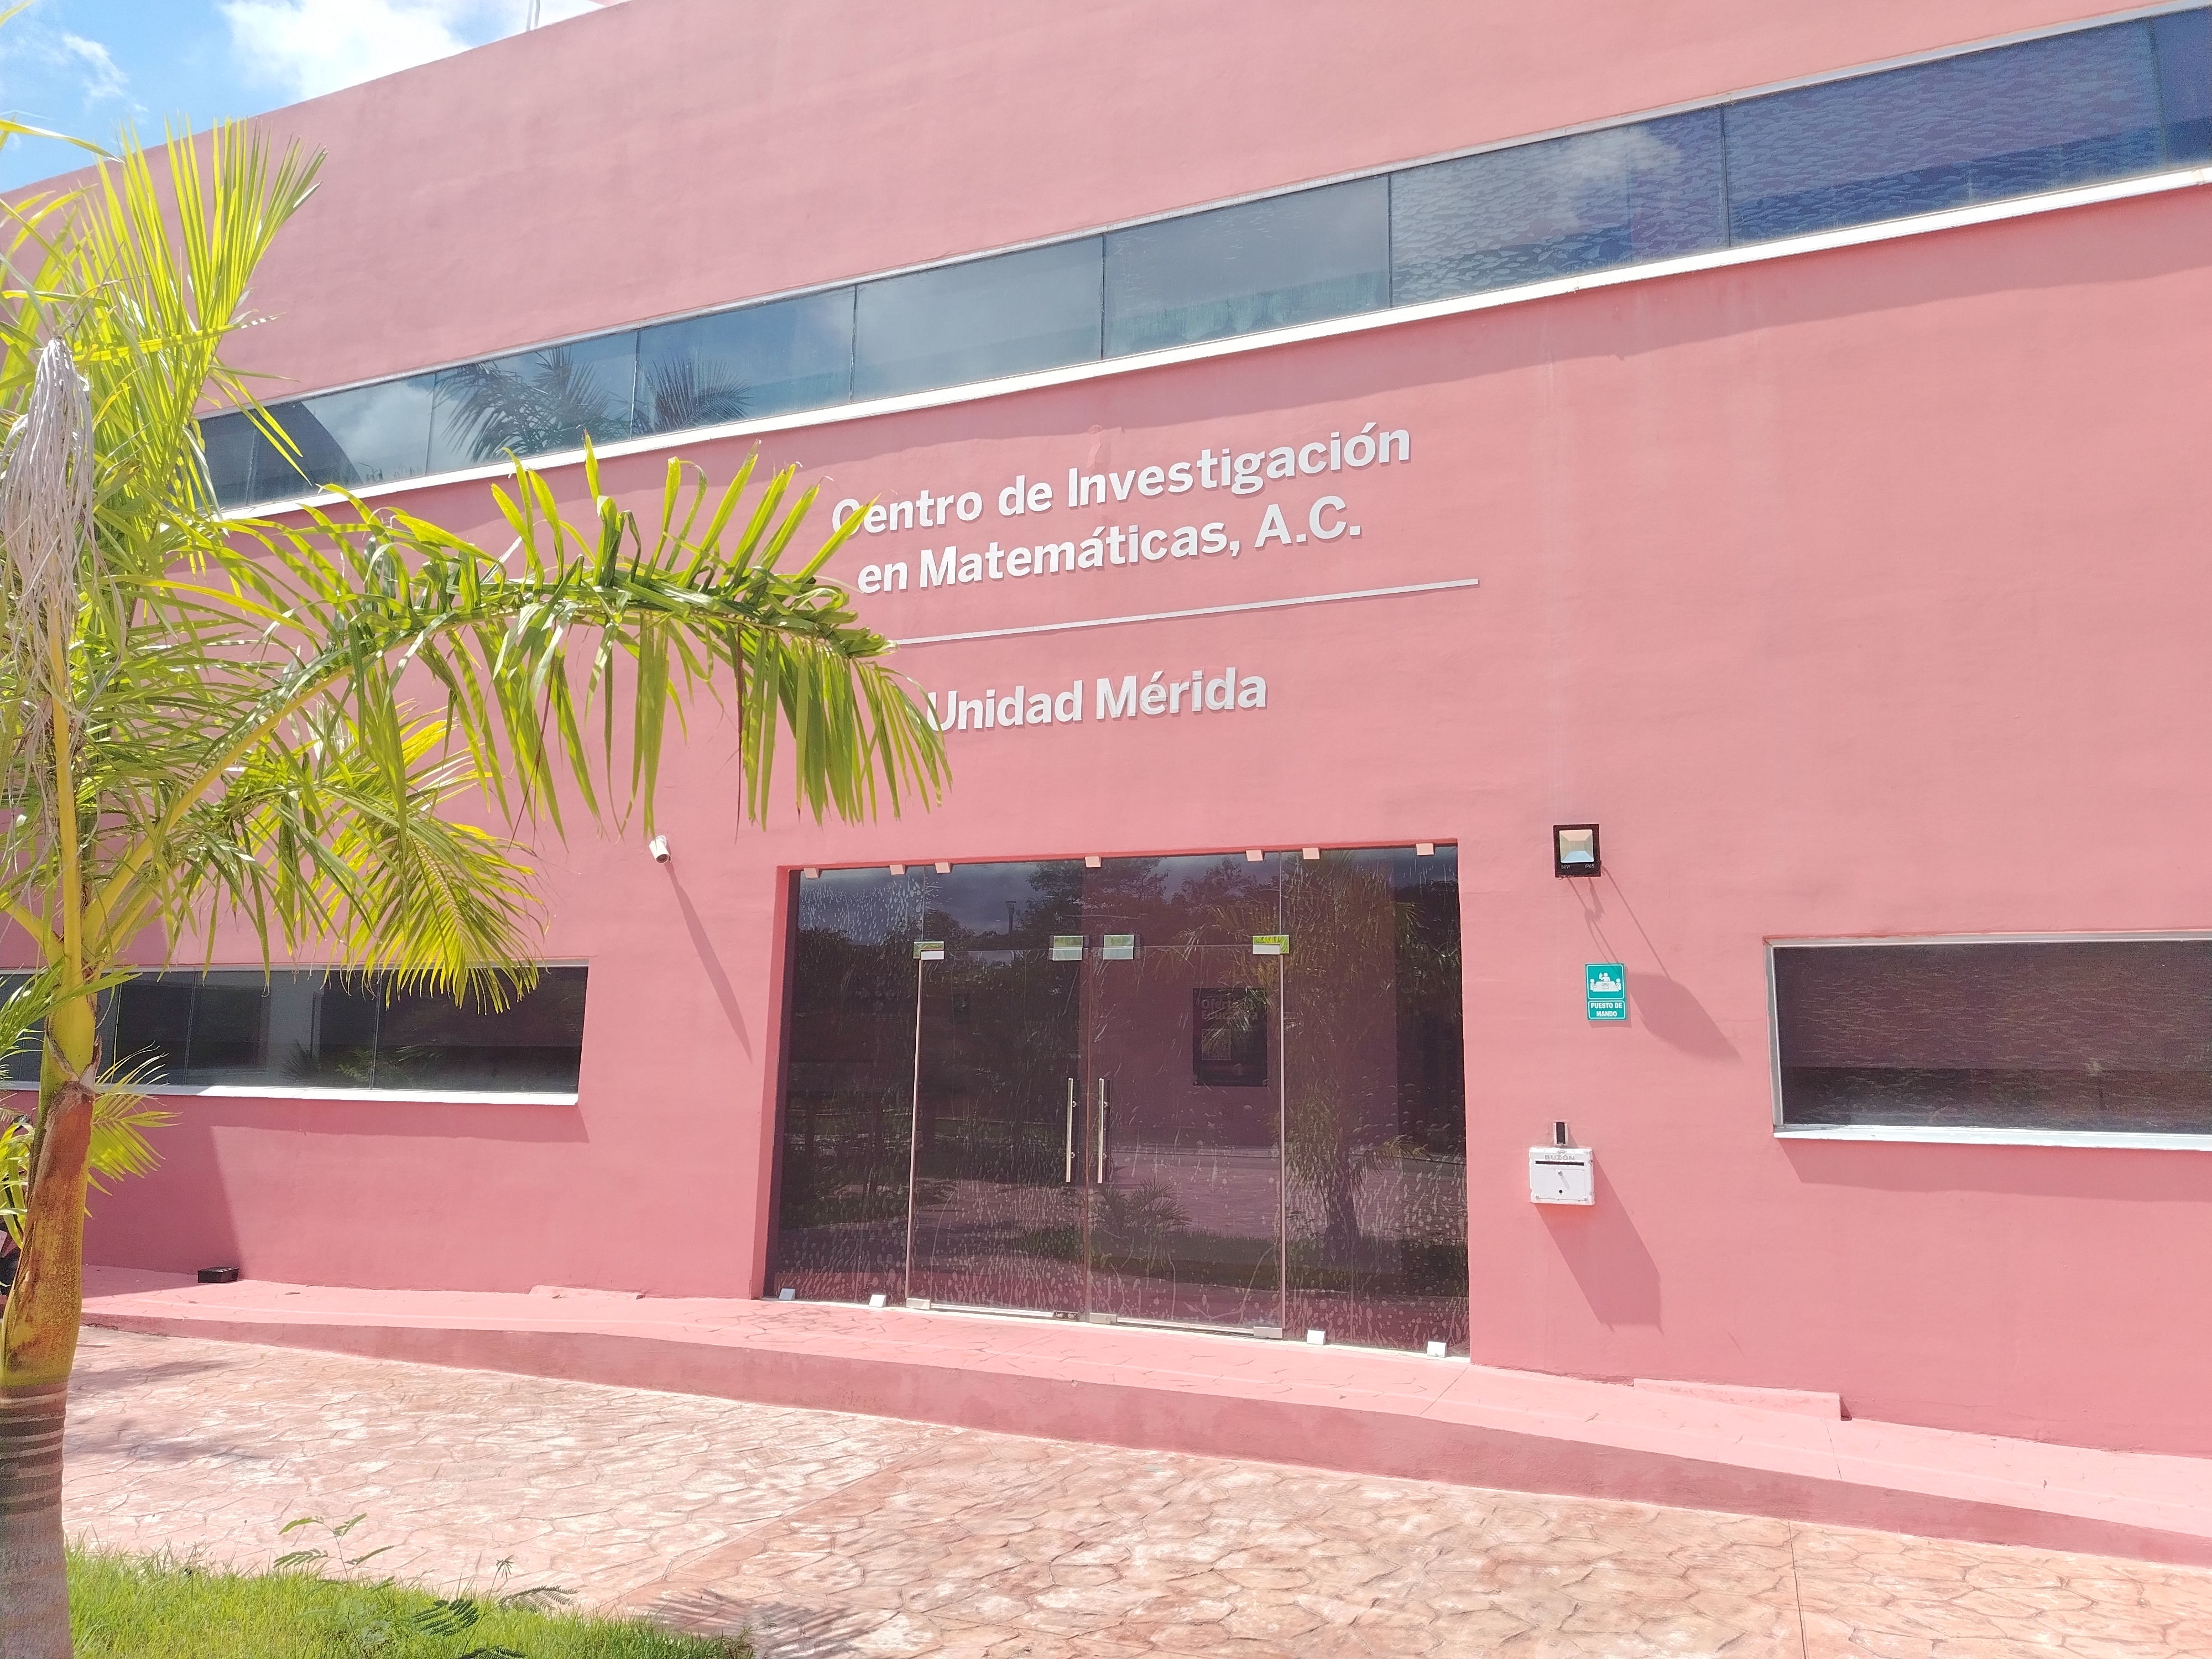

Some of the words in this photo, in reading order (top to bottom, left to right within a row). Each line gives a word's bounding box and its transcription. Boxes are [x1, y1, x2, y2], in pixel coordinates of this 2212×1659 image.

[832, 489, 983, 536] Centro
[998, 474, 1053, 517] de
[1068, 422, 1410, 508] Investigación
[858, 561, 908, 594] en
[919, 521, 1240, 588] Matemáticas,
[1254, 495, 1361, 548] A.C.
[927, 680, 1083, 732] Unidad
[1095, 667, 1267, 721] Mérida
